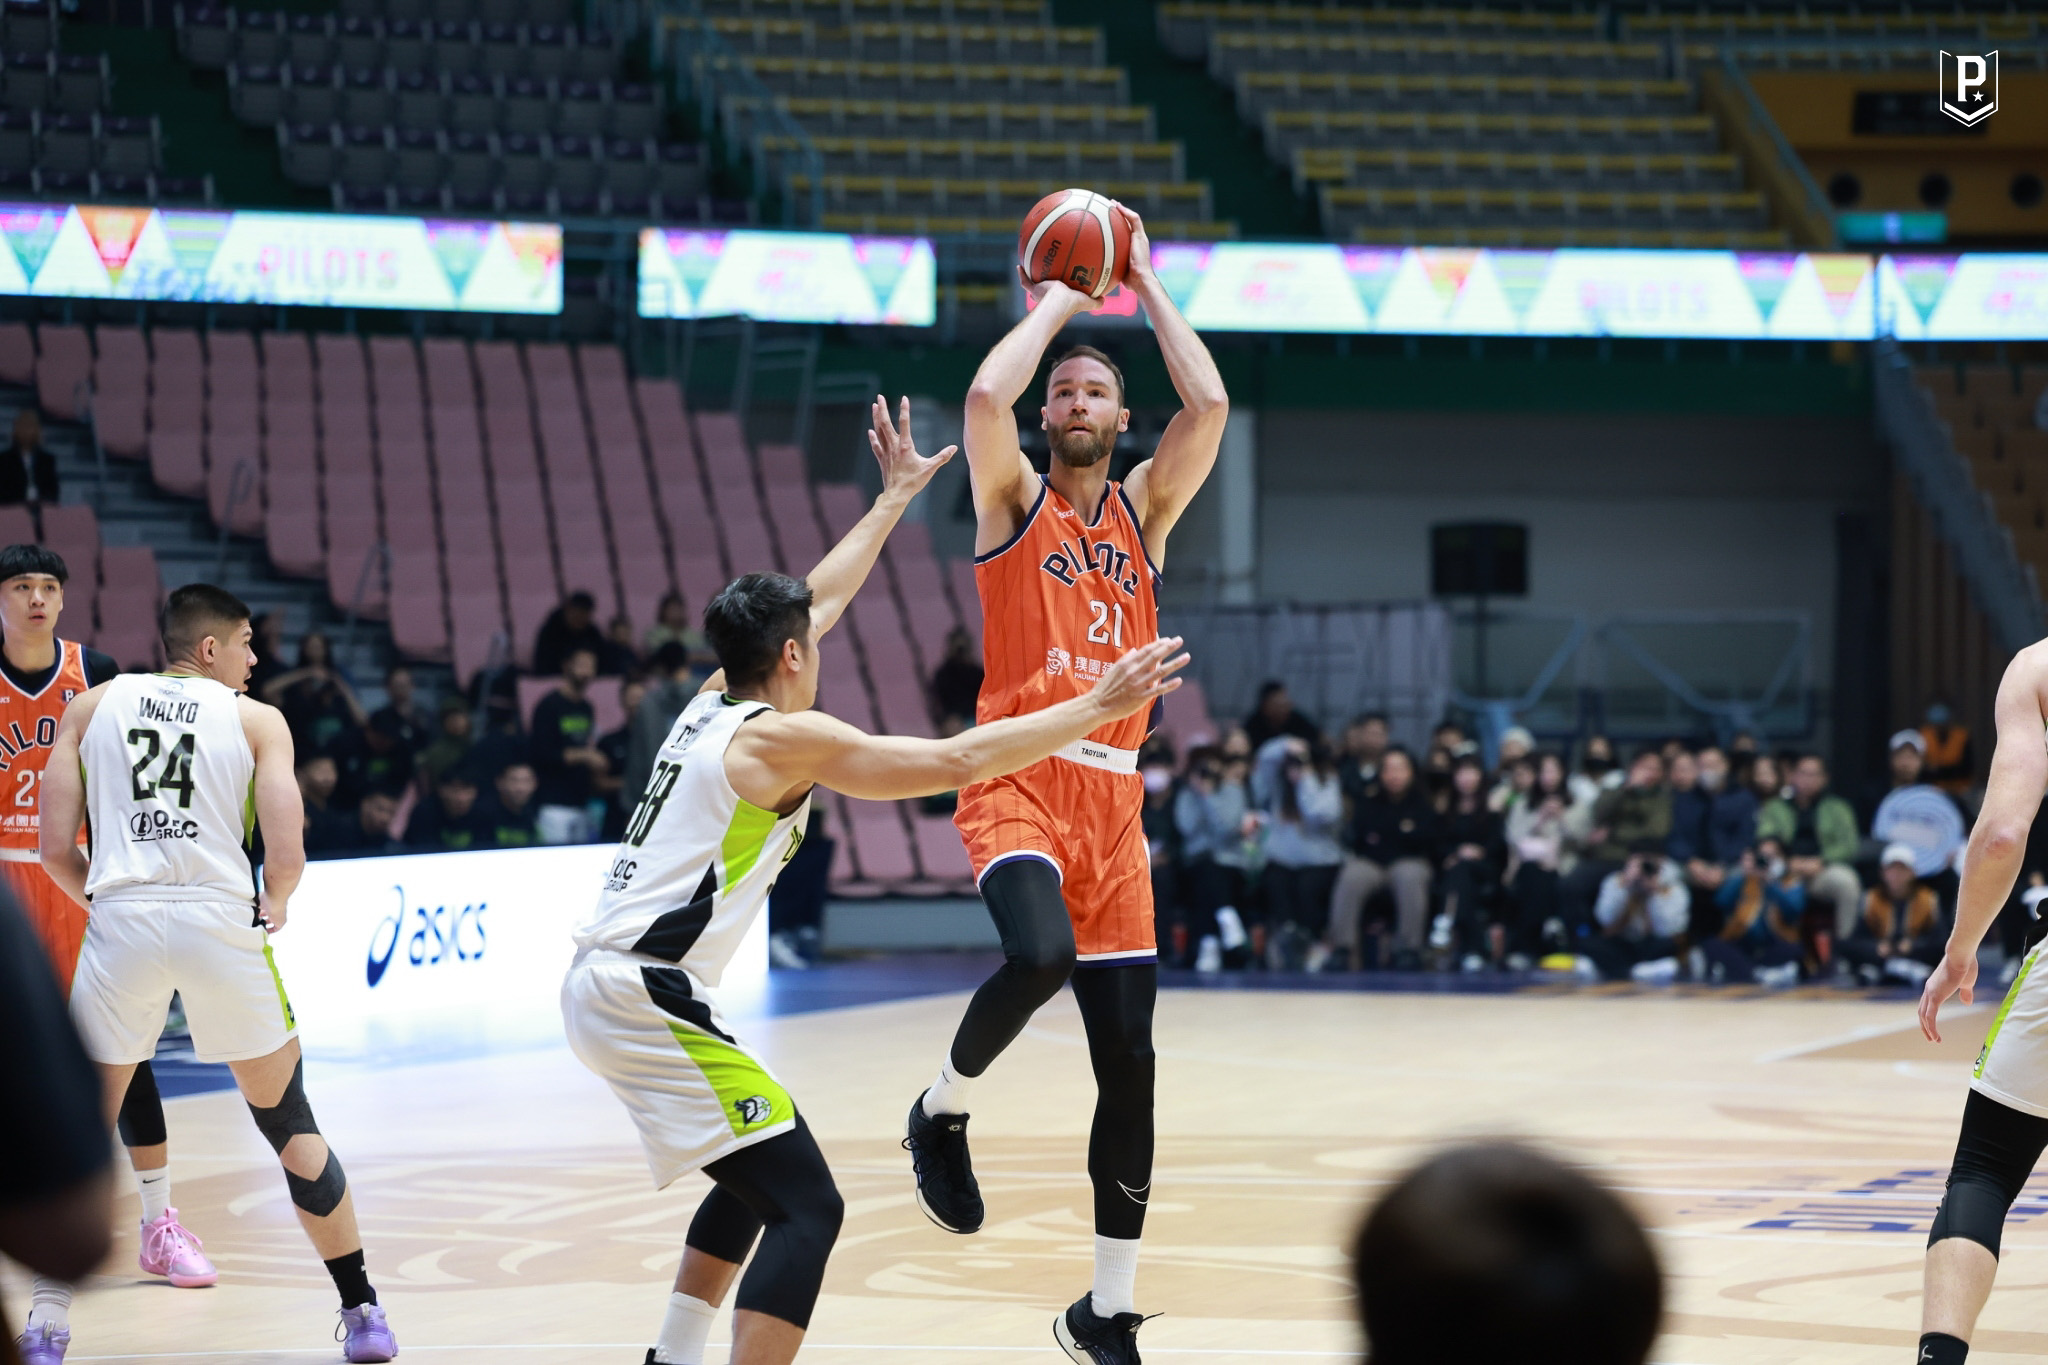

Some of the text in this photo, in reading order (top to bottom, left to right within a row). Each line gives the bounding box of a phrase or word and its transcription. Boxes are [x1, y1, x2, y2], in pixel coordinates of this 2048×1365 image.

[259, 243, 398, 291] PILOTS
[1087, 599, 1124, 648] 21
[139, 697, 199, 724] WALKO
[127, 728, 195, 809] 24
[1081, 748, 1108, 759] TAOYUAN
[14, 769, 44, 807] 2
[409, 902, 487, 967] asics
